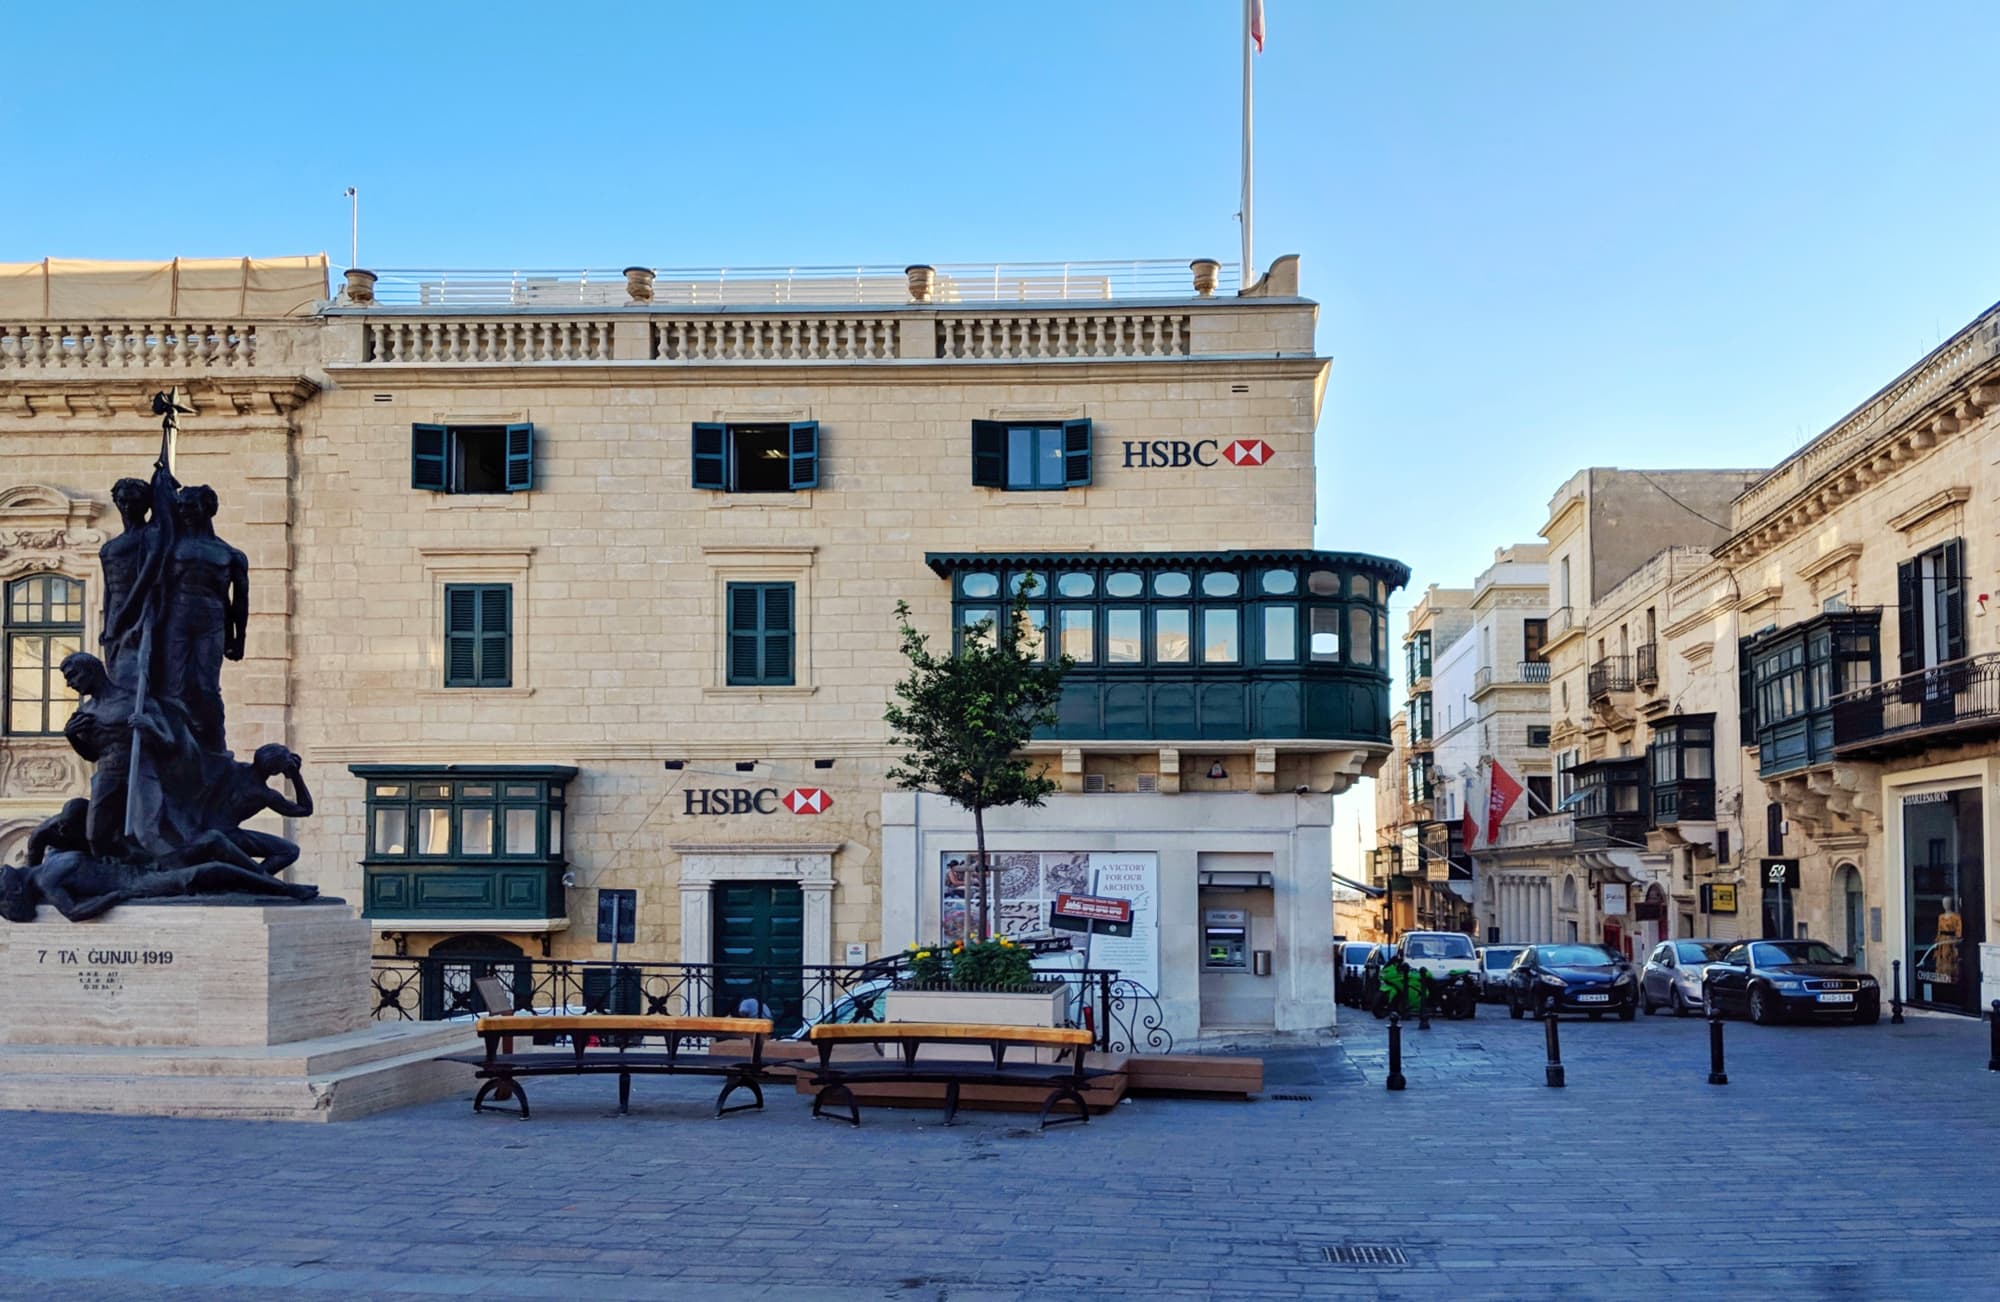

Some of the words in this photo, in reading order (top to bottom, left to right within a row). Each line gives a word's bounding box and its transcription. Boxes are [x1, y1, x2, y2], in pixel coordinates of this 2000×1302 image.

[1122, 439, 1218, 468] HSBC
[682, 788, 778, 816] HSBC
[1109, 863, 1146, 872] VICTORY
[1105, 873, 1122, 881] FOR
[1124, 873, 1142, 881] OUR
[1103, 883, 1145, 891] ARCHIVES
[37, 950, 48, 964] 7
[142, 950, 174, 965] 1919
